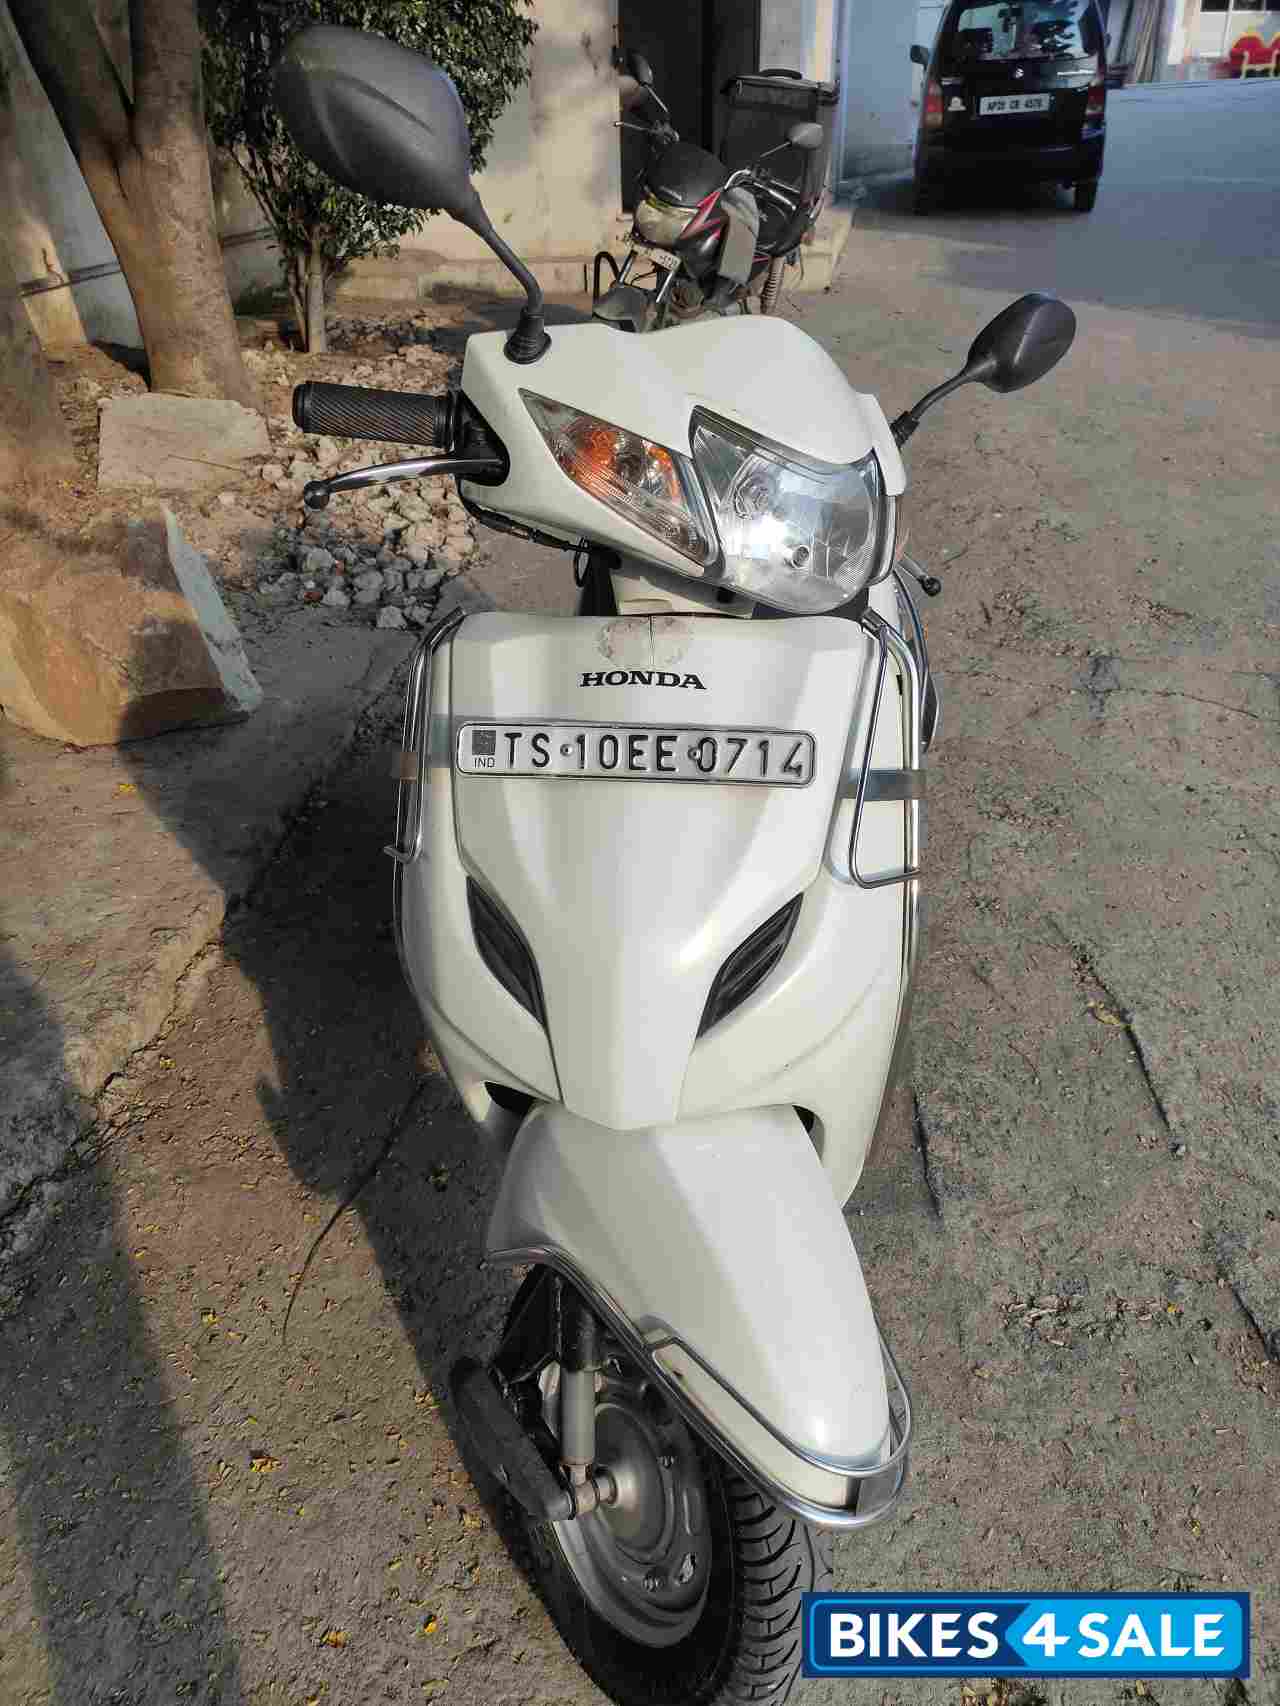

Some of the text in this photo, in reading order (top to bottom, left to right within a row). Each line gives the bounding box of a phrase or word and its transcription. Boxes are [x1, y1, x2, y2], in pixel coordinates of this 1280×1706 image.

[580, 671, 707, 690] HONDA
[474, 757, 496, 769] IND
[696, 736, 803, 778] 0714
